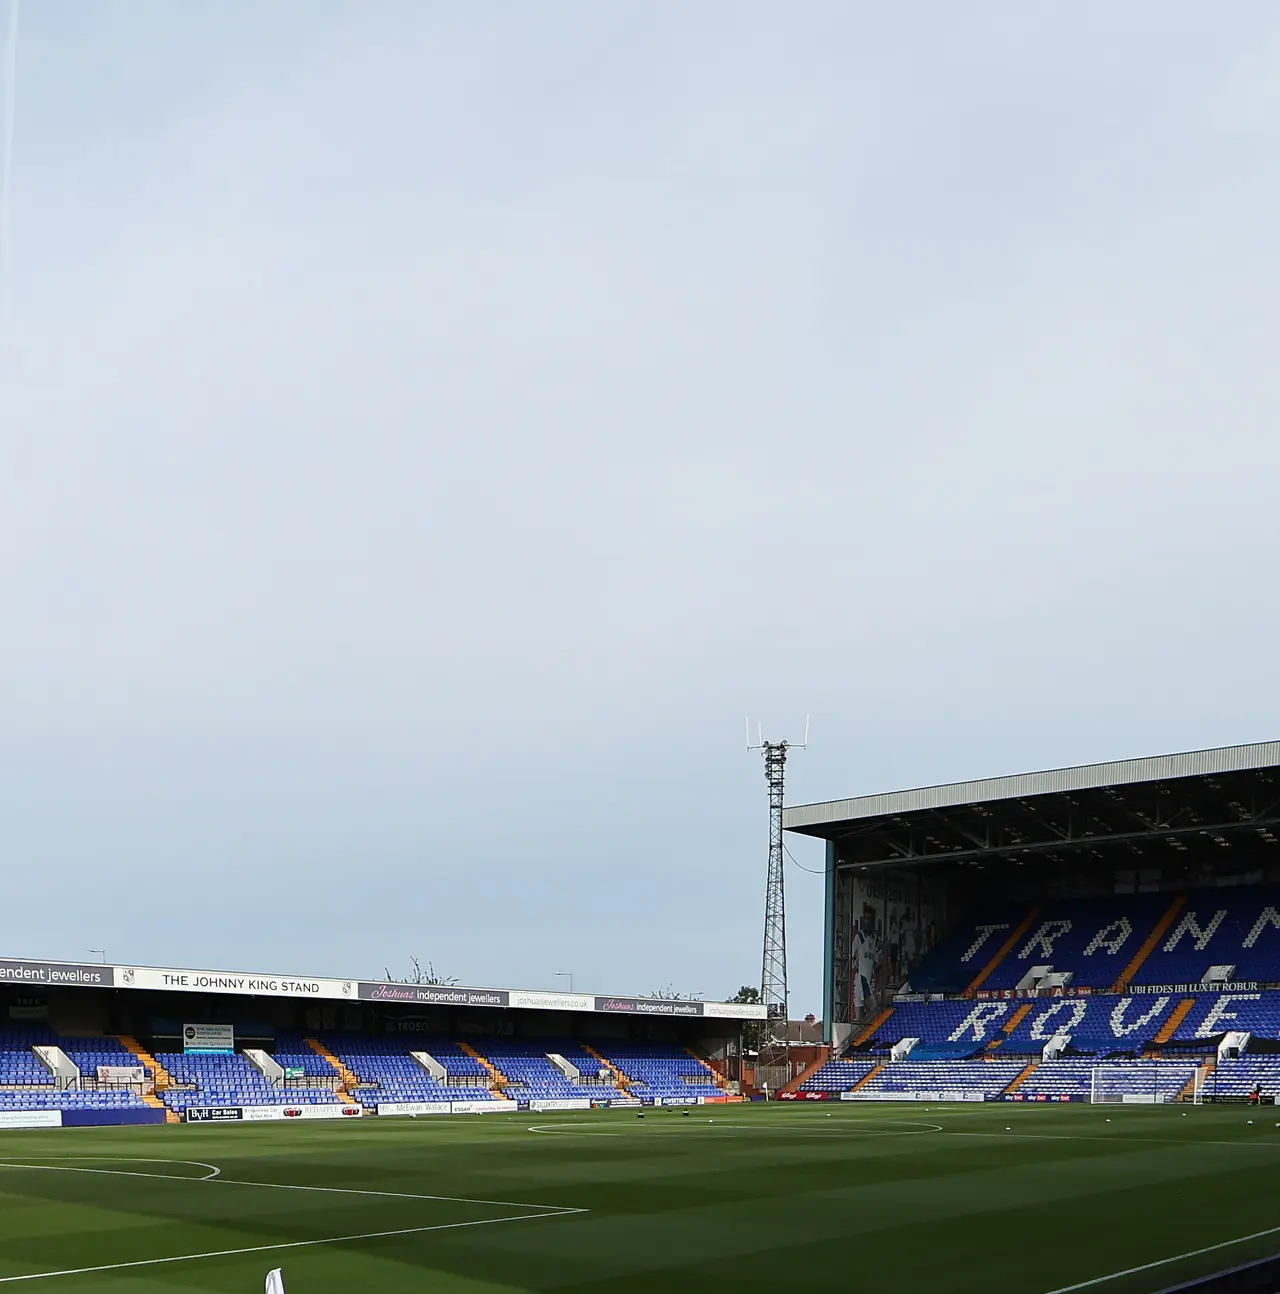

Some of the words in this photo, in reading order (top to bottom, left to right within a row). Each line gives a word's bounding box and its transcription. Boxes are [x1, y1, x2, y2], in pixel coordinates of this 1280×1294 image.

[47, 967, 101, 983] jewellers
[163, 975, 189, 986] THE
[192, 976, 245, 990] JOHNNY
[249, 979, 278, 991] KING
[281, 981, 320, 993] STAND
[1130, 986, 1145, 994] UBI
[1147, 985, 1173, 994] FIDES
[1175, 985, 1187, 993] IBI
[1189, 984, 1208, 992] LUX
[1209, 984, 1219, 992] ET
[1222, 982, 1258, 992] ROBUR
[371, 984, 414, 999] Joshuas
[416, 990, 467, 1004] independent
[467, 993, 501, 1005] jewellers
[1026, 989, 1039, 998] W
[1053, 988, 1063, 997] A
[517, 996, 588, 1009] joshuasjewellers.co.uk
[603, 999, 634, 1011] Joshuas
[636, 1002, 673, 1014] independent
[673, 1004, 697, 1015] jewellers
